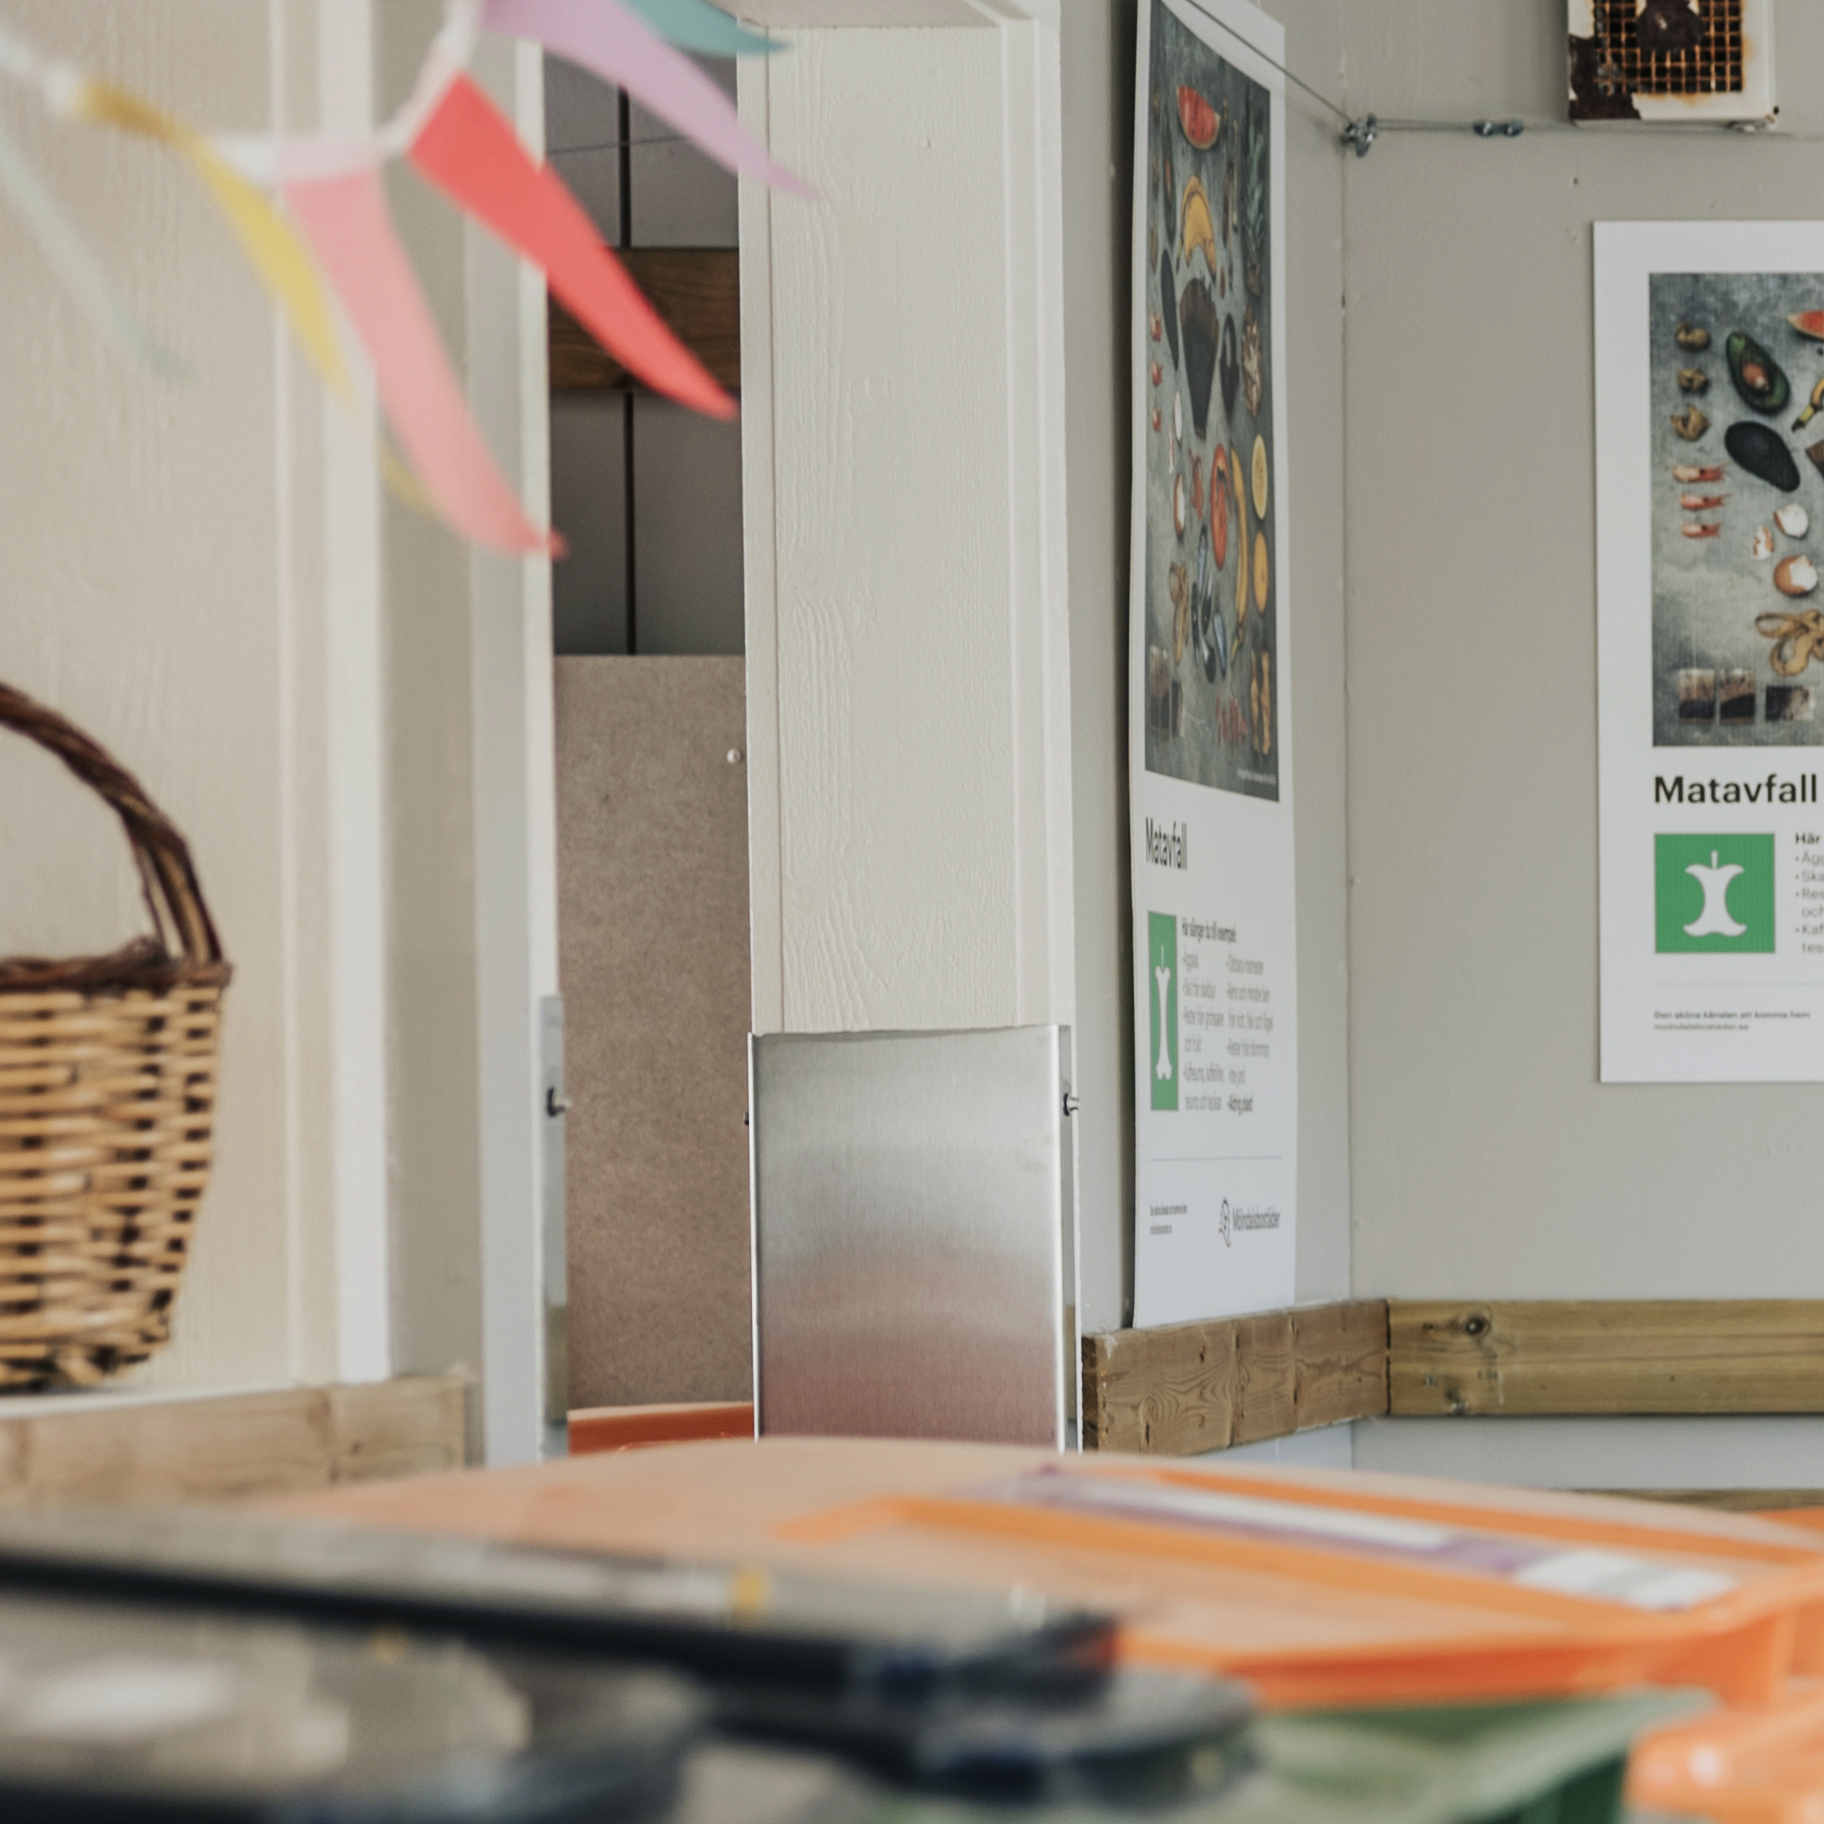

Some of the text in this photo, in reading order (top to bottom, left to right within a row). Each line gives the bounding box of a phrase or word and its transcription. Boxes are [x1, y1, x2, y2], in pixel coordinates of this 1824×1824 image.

[1654, 773, 1816, 803] Matavfall
[1145, 816, 1188, 870] Matavfall
[1794, 832, 1820, 844] Här
